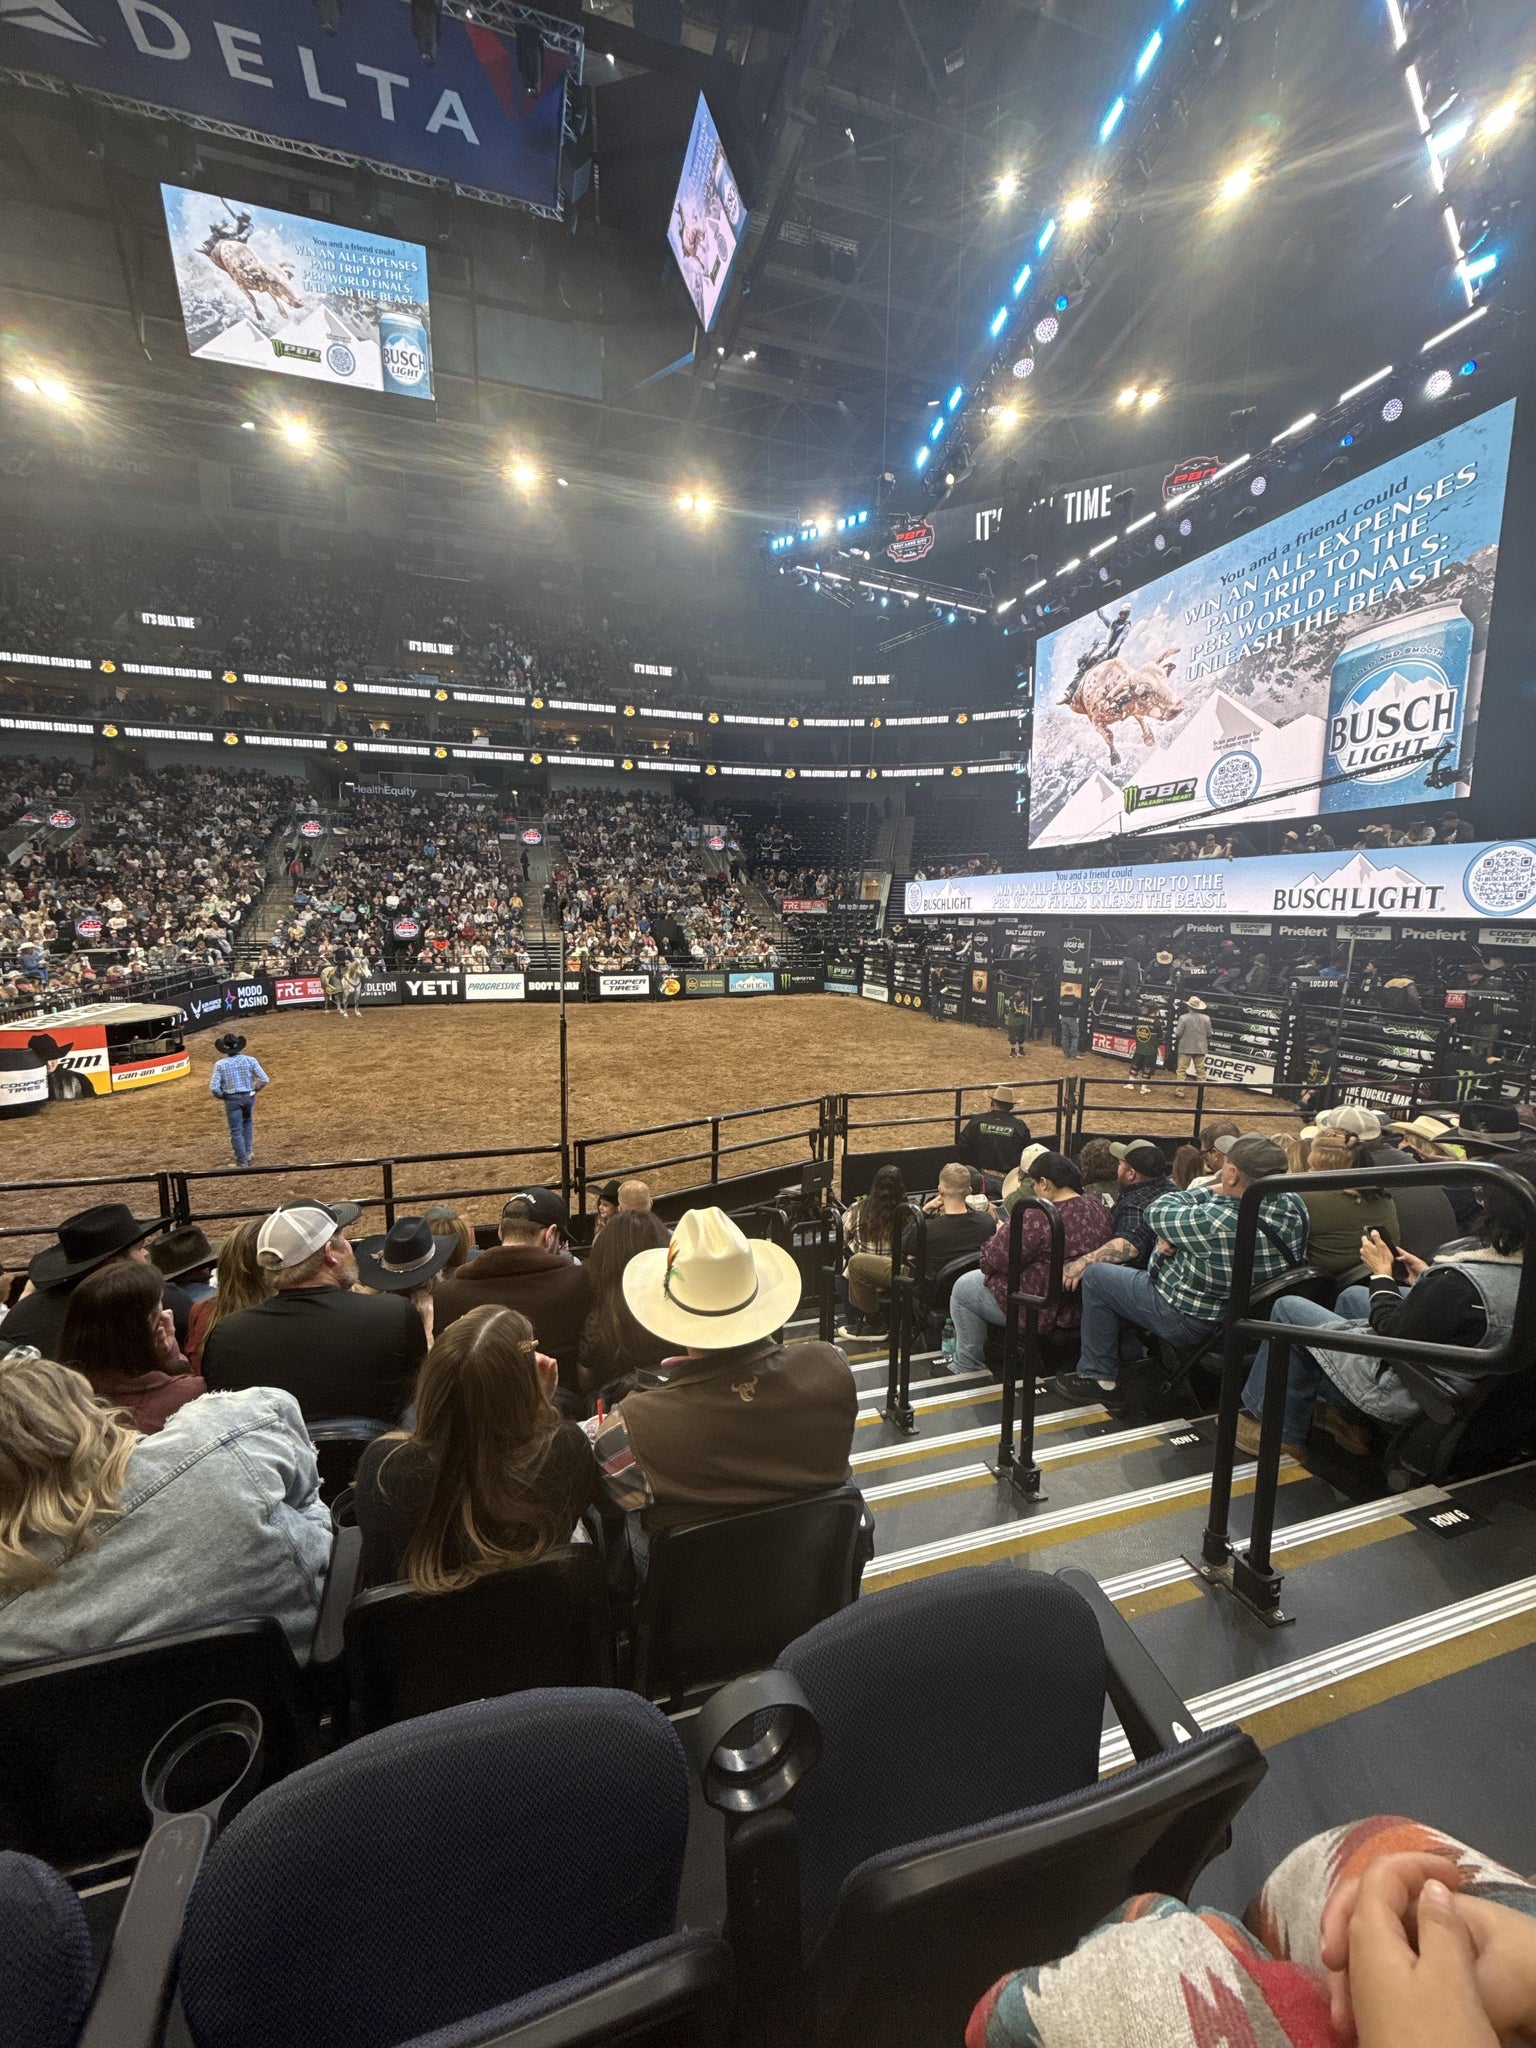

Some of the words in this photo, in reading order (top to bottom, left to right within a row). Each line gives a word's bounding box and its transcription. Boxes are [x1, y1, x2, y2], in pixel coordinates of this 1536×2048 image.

[115, 0, 480, 145] DELTA
[312, 237, 327, 246] You
[328, 240, 342, 249] and
[351, 243, 373, 253] friend
[375, 247, 395, 256] could
[295, 244, 317, 257] WIN
[319, 249, 335, 260] AN
[338, 252, 417, 272] ALL-EXPENSES
[310, 259, 335, 271] PAID
[339, 262, 363, 275] TRIP
[366, 267, 381, 277] TO
[384, 269, 404, 281] THE
[303, 270, 325, 280] PBR
[328, 273, 369, 287] WORLD
[303, 281, 354, 298] UNLEASH
[357, 288, 377, 300] THE
[380, 292, 416, 306] BEAST.
[383, 348, 425, 371] BUSCH
[391, 365, 419, 378] LIGHT
[1064, 484, 1112, 525] TIME
[1220, 568, 1244, 587] You
[1249, 552, 1277, 572] and
[1281, 543, 1290, 554] a
[1296, 509, 1348, 548] friend
[1353, 476, 1408, 516] could
[1184, 595, 1223, 626] WIN
[1227, 574, 1259, 605] AN
[1264, 462, 1478, 586] ALL-EXPENSES
[1205, 600, 1255, 636] PAID
[1262, 569, 1317, 608] TRIP
[1324, 549, 1361, 578] TO
[1369, 512, 1430, 556] THE
[1190, 632, 1231, 662] PBR
[1238, 588, 1327, 640] WORLD
[1333, 533, 1450, 598] FINALS:
[142, 612, 157, 625] IT'S
[176, 616, 195, 628] TIME
[1186, 628, 1284, 682] UNLEASH
[1293, 603, 1341, 638] THE
[1348, 554, 1451, 615] BEAST.
[12, 653, 51, 665] ADVENTURE
[51, 657, 76, 668] STARTS
[1352, 661, 1375, 680] COLD
[1379, 651, 1400, 662] AND
[1404, 647, 1444, 657] SMOOTH
[15, 719, 54, 731] ADVENTURE
[54, 722, 78, 733] STARTS
[1330, 691, 1456, 753] BUSCH
[1223, 741, 1241, 749] chance
[1226, 735, 1237, 743] and
[1347, 737, 1429, 767] LIGHT
[353, 784, 417, 798] HealthEquity
[1140, 780, 1195, 800] PBR
[1056, 872, 1068, 881] You
[1069, 871, 1082, 880] and
[1089, 868, 1110, 880] friend
[1112, 867, 1133, 878] could
[996, 883, 1013, 896] WIN
[1016, 882, 1029, 895] AN
[1031, 879, 1103, 895] ALL-EXPENSES
[1106, 878, 1133, 893] PAID
[1137, 876, 1165, 892] TRIP
[1169, 875, 1189, 891] TO
[1193, 873, 1223, 891] THE
[1012, 896, 1045, 909] WORLD
[1090, 893, 1142, 908] UNLEASH
[1145, 893, 1173, 908] THE
[1176, 892, 1227, 909] BEAST.
[1033, 929, 1046, 937] CITY
[1187, 923, 1224, 933] Priefert
[1279, 925, 1328, 937] Priefert
[1344, 926, 1383, 934] COOPER
[1402, 927, 1467, 941] Priefert
[1495, 936, 1531, 944] TIRES
[237, 985, 262, 997] MODO
[276, 981, 305, 998] FRE
[405, 979, 458, 996] YETI
[468, 982, 522, 991] PROGRESSIVE
[528, 981, 553, 991] BOOT
[1310, 980, 1328, 988] LUCAS
[1329, 980, 1338, 988] OIL
[238, 995, 268, 1009] CASINO
[1092, 1033, 1112, 1049] FRE
[161, 1062, 185, 1073] can-am
[1204, 1057, 1256, 1075] OOPER
[118, 1069, 155, 1081] can-am
[0, 1080, 45, 1089] COOPER
[8, 1085, 42, 1094] TIRES
[1361, 1087, 1392, 1104] BUCKLE
[1170, 1434, 1191, 1446] ROW
[1192, 1433, 1200, 1443] 5
[1431, 1510, 1458, 1528] ROW
[1459, 1508, 1471, 1522] 6
